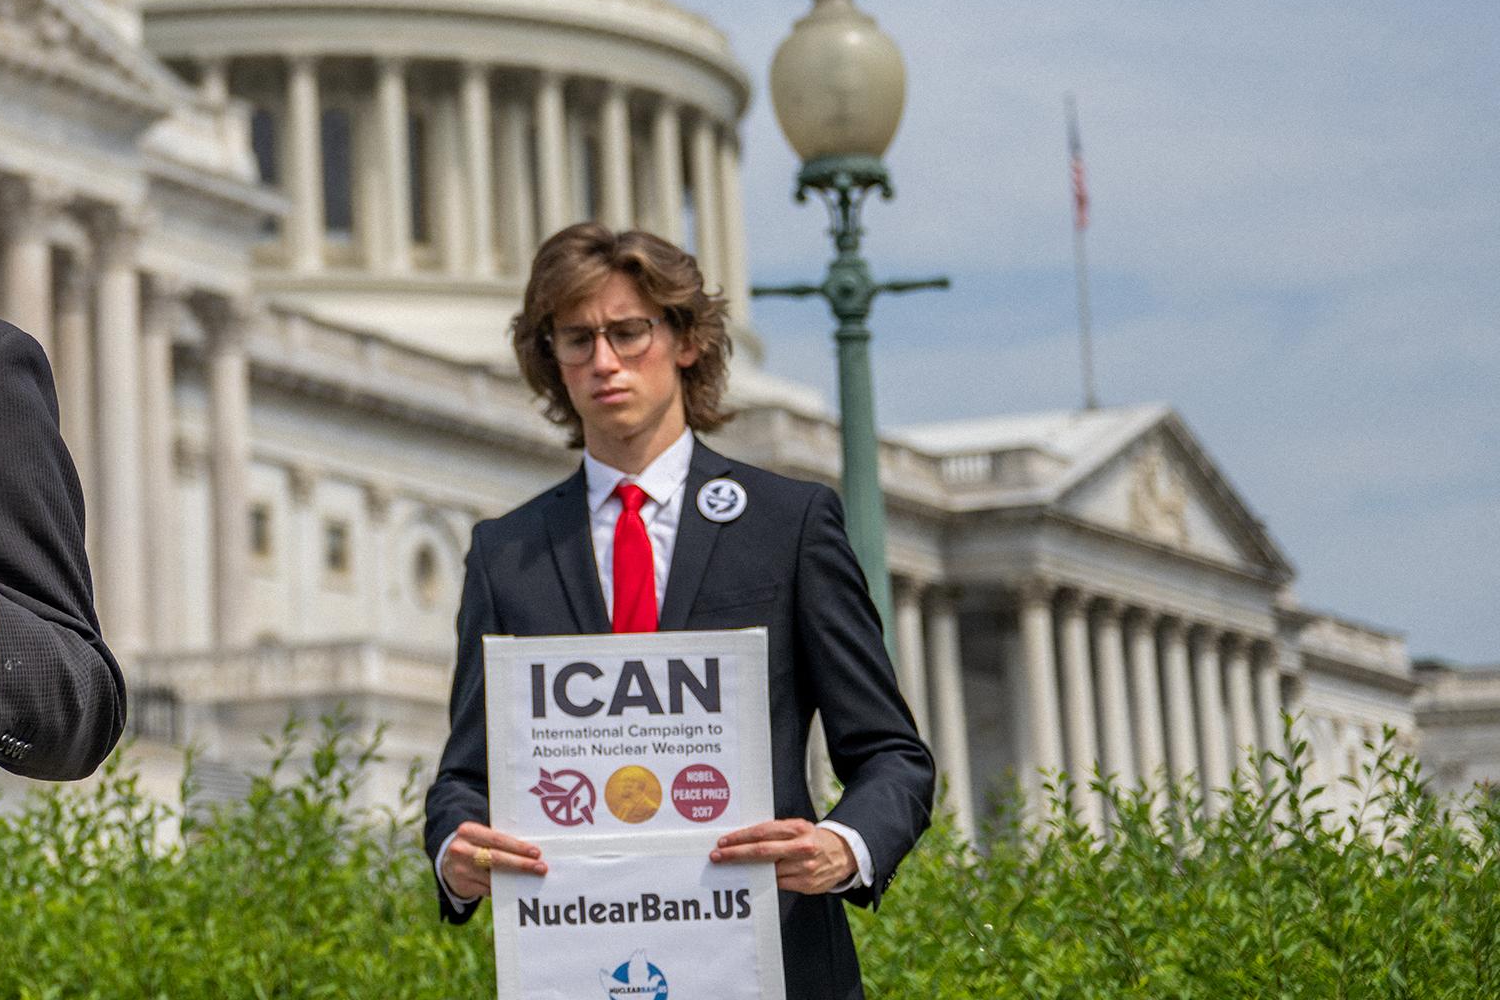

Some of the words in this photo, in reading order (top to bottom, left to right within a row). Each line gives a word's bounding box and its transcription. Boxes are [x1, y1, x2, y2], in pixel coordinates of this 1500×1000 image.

[530, 657, 722, 719] ICAN
[531, 726, 624, 741] International
[628, 723, 704, 739] Campaign
[707, 723, 723, 736] to
[532, 745, 587, 758] Abolish
[591, 743, 647, 756] Nuclear
[652, 741, 722, 756] Weapons
[686, 770, 716, 783] NOBEL
[673, 789, 702, 801] PEACE
[702, 787, 729, 800] PRIZE
[692, 805, 713, 818] 2017
[517, 888, 752, 927] NuclearBan.US
